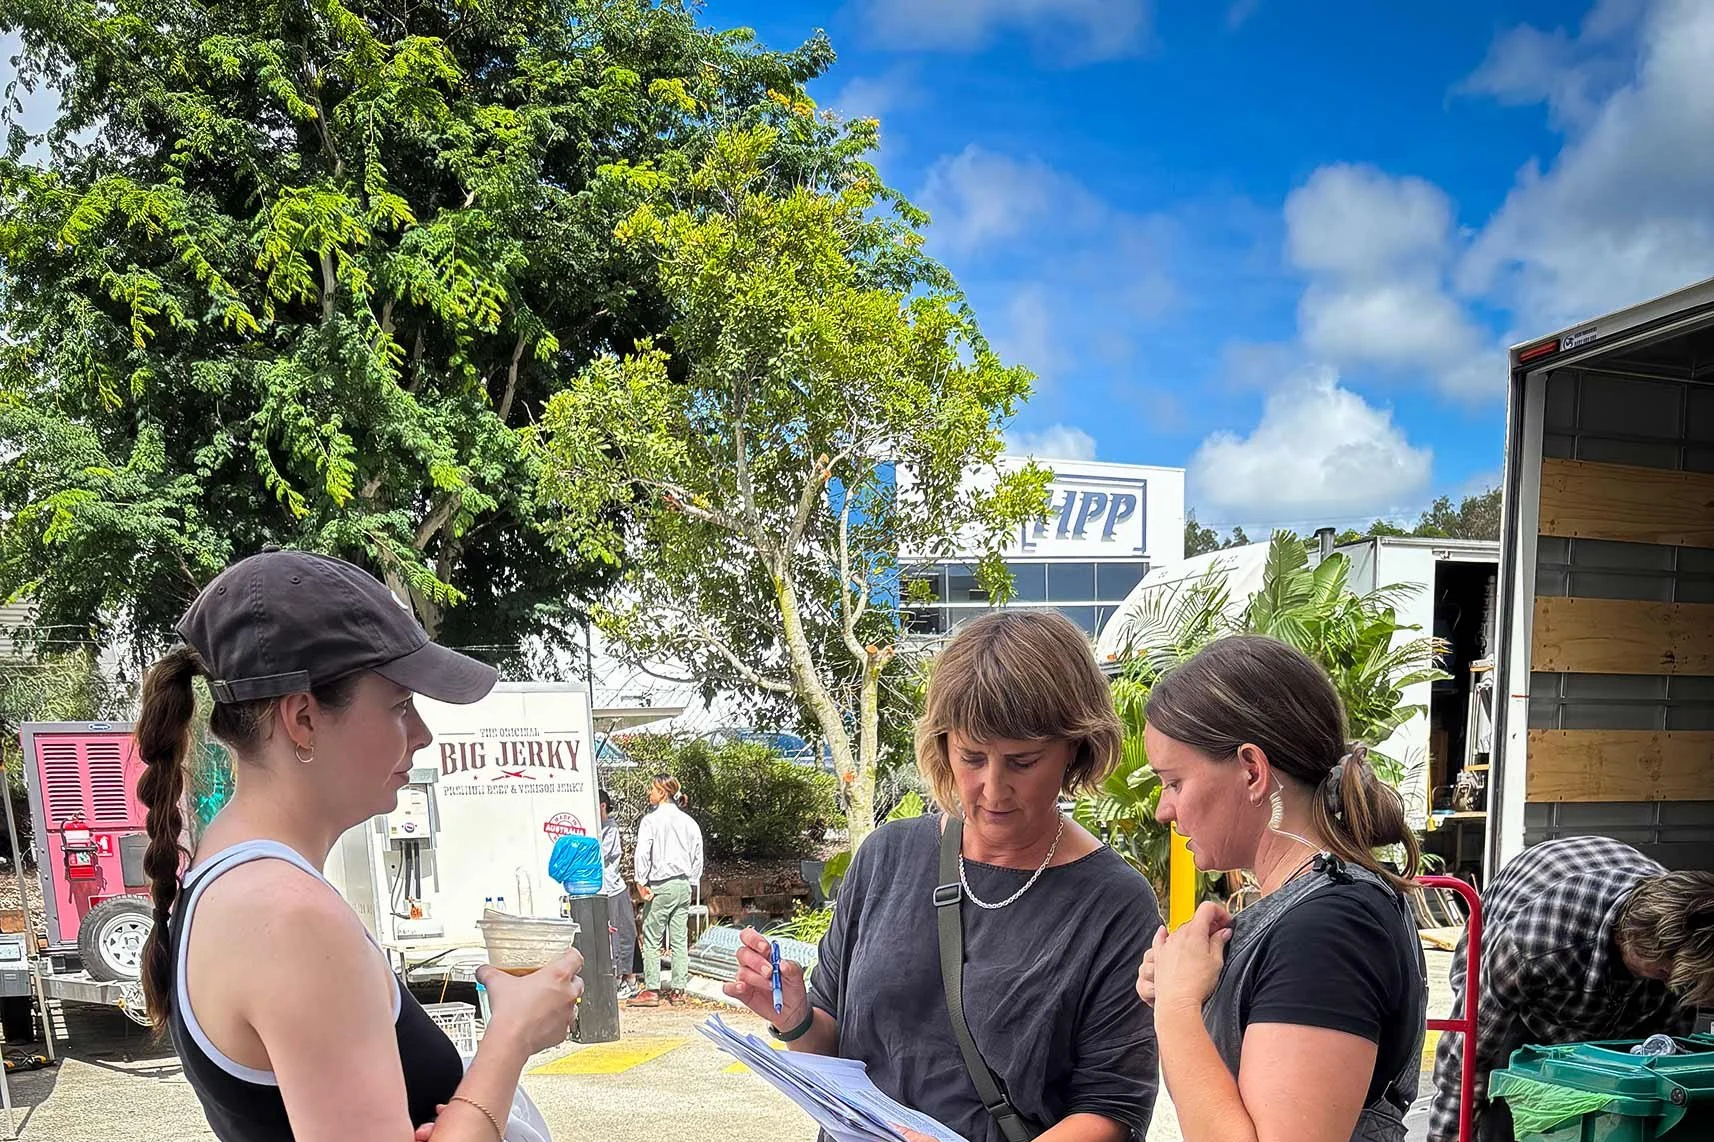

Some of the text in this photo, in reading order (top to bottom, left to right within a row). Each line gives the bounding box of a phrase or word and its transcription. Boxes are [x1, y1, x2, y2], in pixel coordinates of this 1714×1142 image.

[1032, 489, 1137, 542] HPP
[499, 727, 540, 738] ORIGINAL
[439, 740, 580, 776] BIG JERKY
[518, 783, 555, 794] VENISON
[556, 782, 584, 793] JERKY
